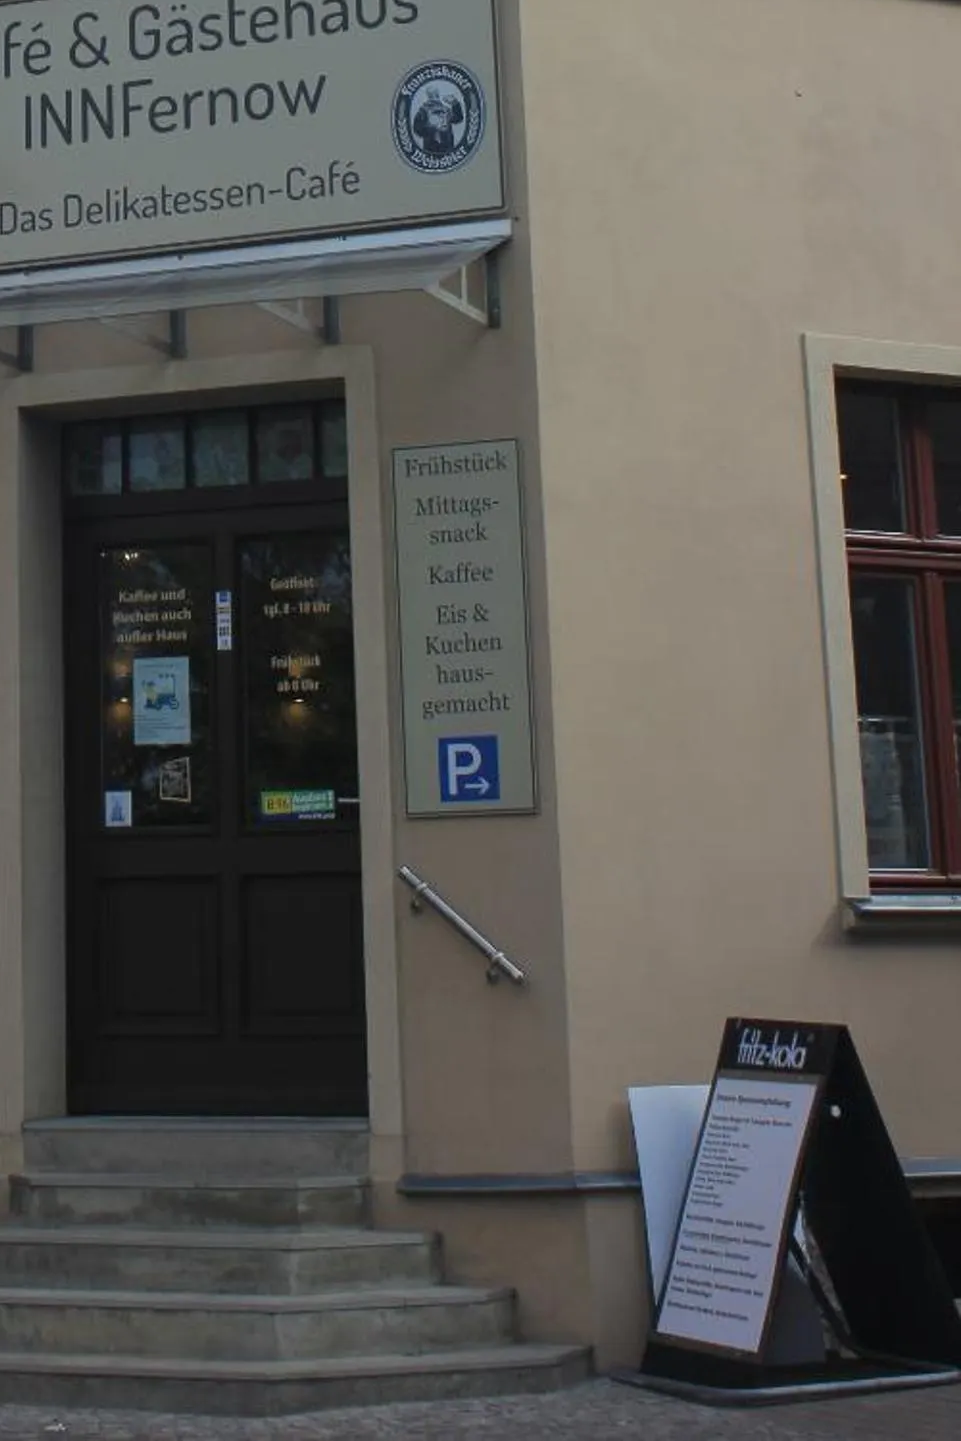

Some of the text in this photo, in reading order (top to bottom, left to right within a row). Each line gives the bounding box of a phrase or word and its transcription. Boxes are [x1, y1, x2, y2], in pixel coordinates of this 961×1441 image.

[68, 11, 111, 69] &
[24, 75, 327, 150] INNFernow
[62, 160, 361, 229] Delikatessen-Café
[404, 450, 507, 479] Frühstück
[415, 495, 500, 518] Mittags-
[429, 521, 488, 545] snack
[428, 563, 494, 587] Kaffee
[436, 602, 490, 626] Eis &
[425, 632, 503, 657] Kuchen
[437, 664, 494, 685] haus-
[421, 691, 511, 721] gemacht
[446, 742, 483, 796] P
